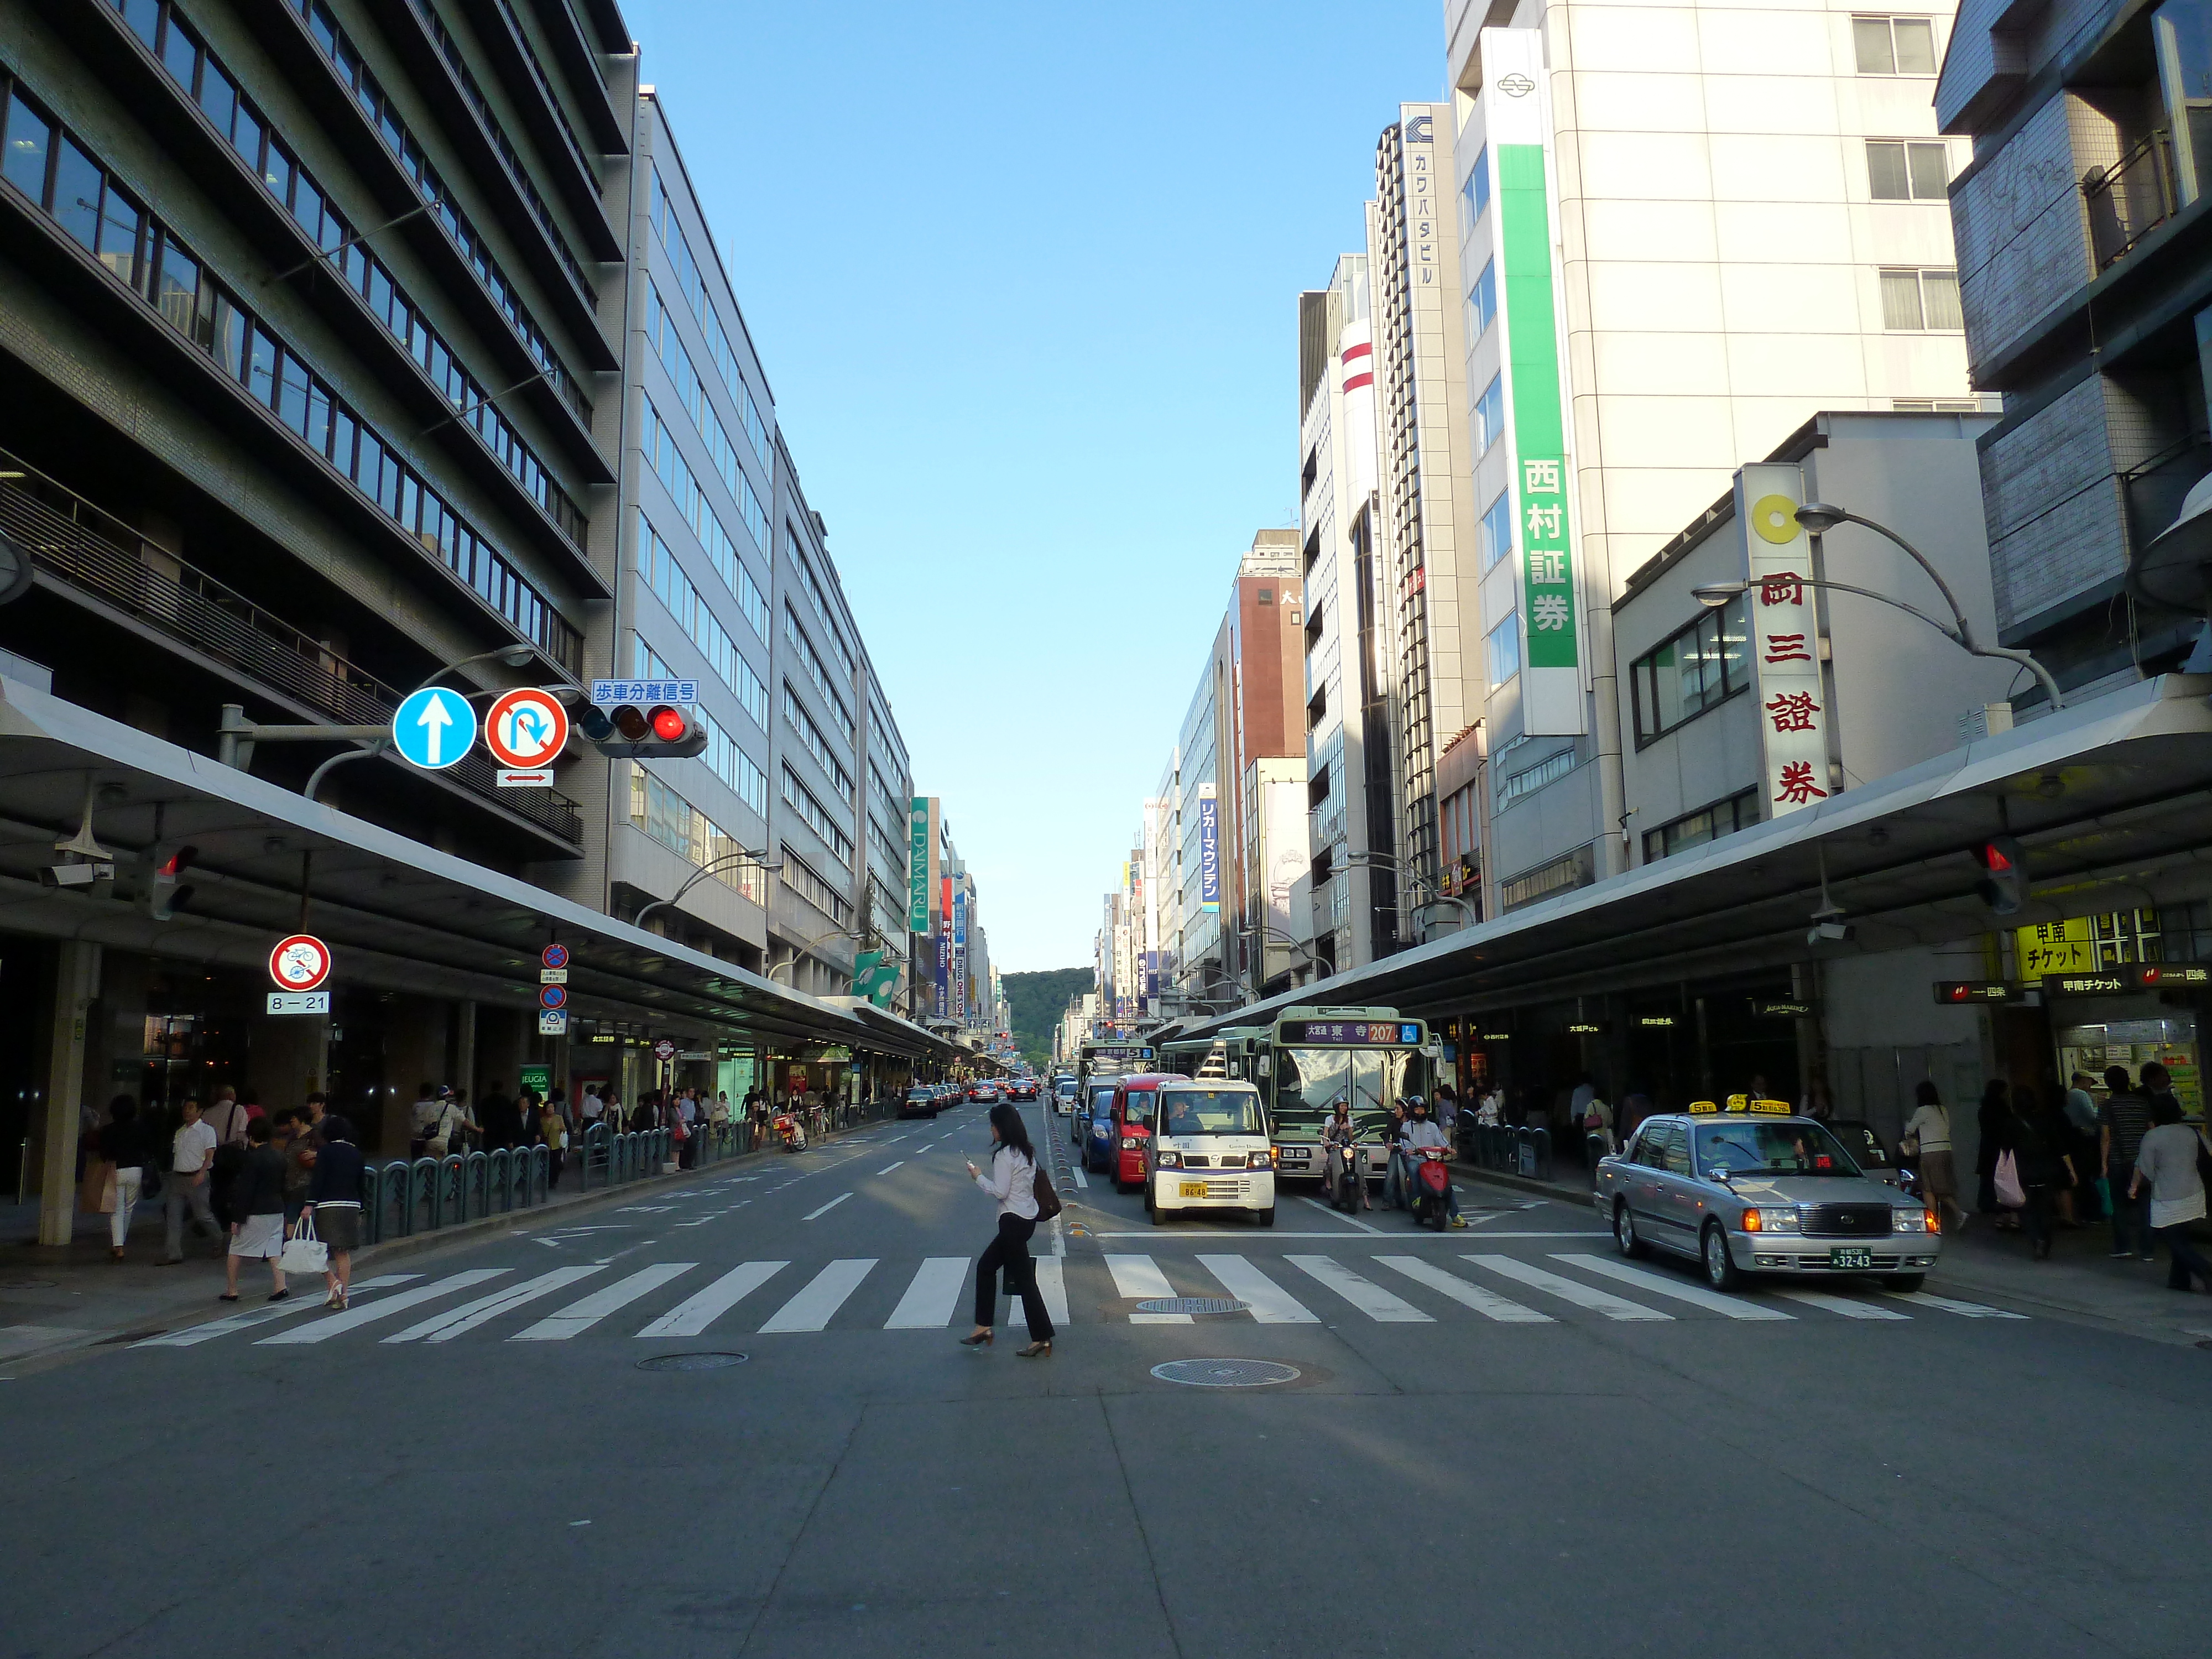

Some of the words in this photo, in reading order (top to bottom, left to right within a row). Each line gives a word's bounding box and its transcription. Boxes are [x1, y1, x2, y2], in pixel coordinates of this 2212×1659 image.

[1416, 155, 1432, 284] カワバタビル
[1524, 459, 1569, 632] 西村証券
[597, 683, 695, 701] 歩車分離信号
[1202, 804, 1217, 897] リカーマウンテン
[914, 833, 926, 919] DAIMARU
[956, 903, 964, 936] 新生銀行
[2037, 921, 2065, 944] 甲南
[2028, 943, 2081, 970] チケット
[2186, 969, 2208, 980] 四条
[1987, 987, 2006, 997] 四条
[2063, 978, 2122, 992] 甲南チケット
[1308, 1025, 1327, 1035] 大宮通
[1370, 1025, 1394, 1041] 207
[1129, 1048, 1138, 1057] 5
[1839, 1255, 1870, 1267] 32-43
